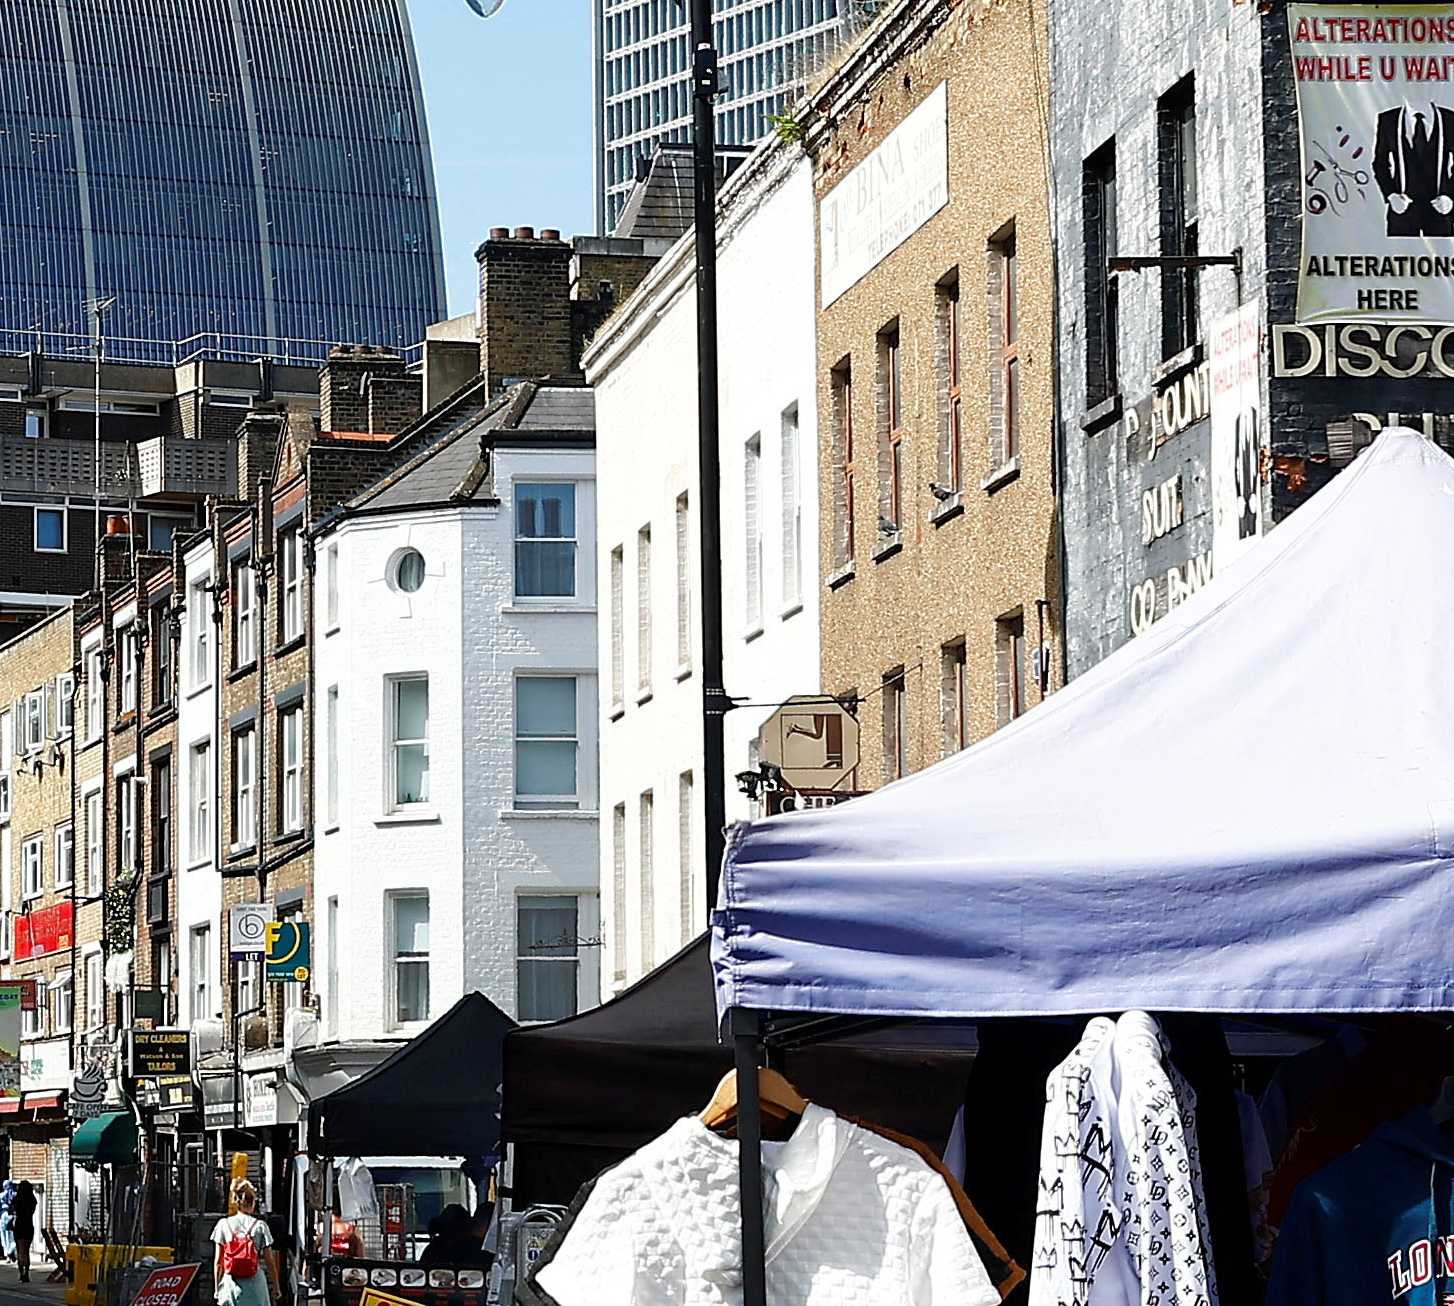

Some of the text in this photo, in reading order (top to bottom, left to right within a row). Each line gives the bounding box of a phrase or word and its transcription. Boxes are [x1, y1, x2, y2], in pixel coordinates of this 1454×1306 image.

[1296, 57, 1372, 83] WHILE
[1380, 57, 1395, 81] U
[1357, 289, 1419, 311] HERE
[1213, 315, 1257, 357] ALTERATIONS
[1142, 473, 1183, 545] SUIT
[245, 953, 259, 961] LET
[150, 1276, 182, 1290] ROAD
